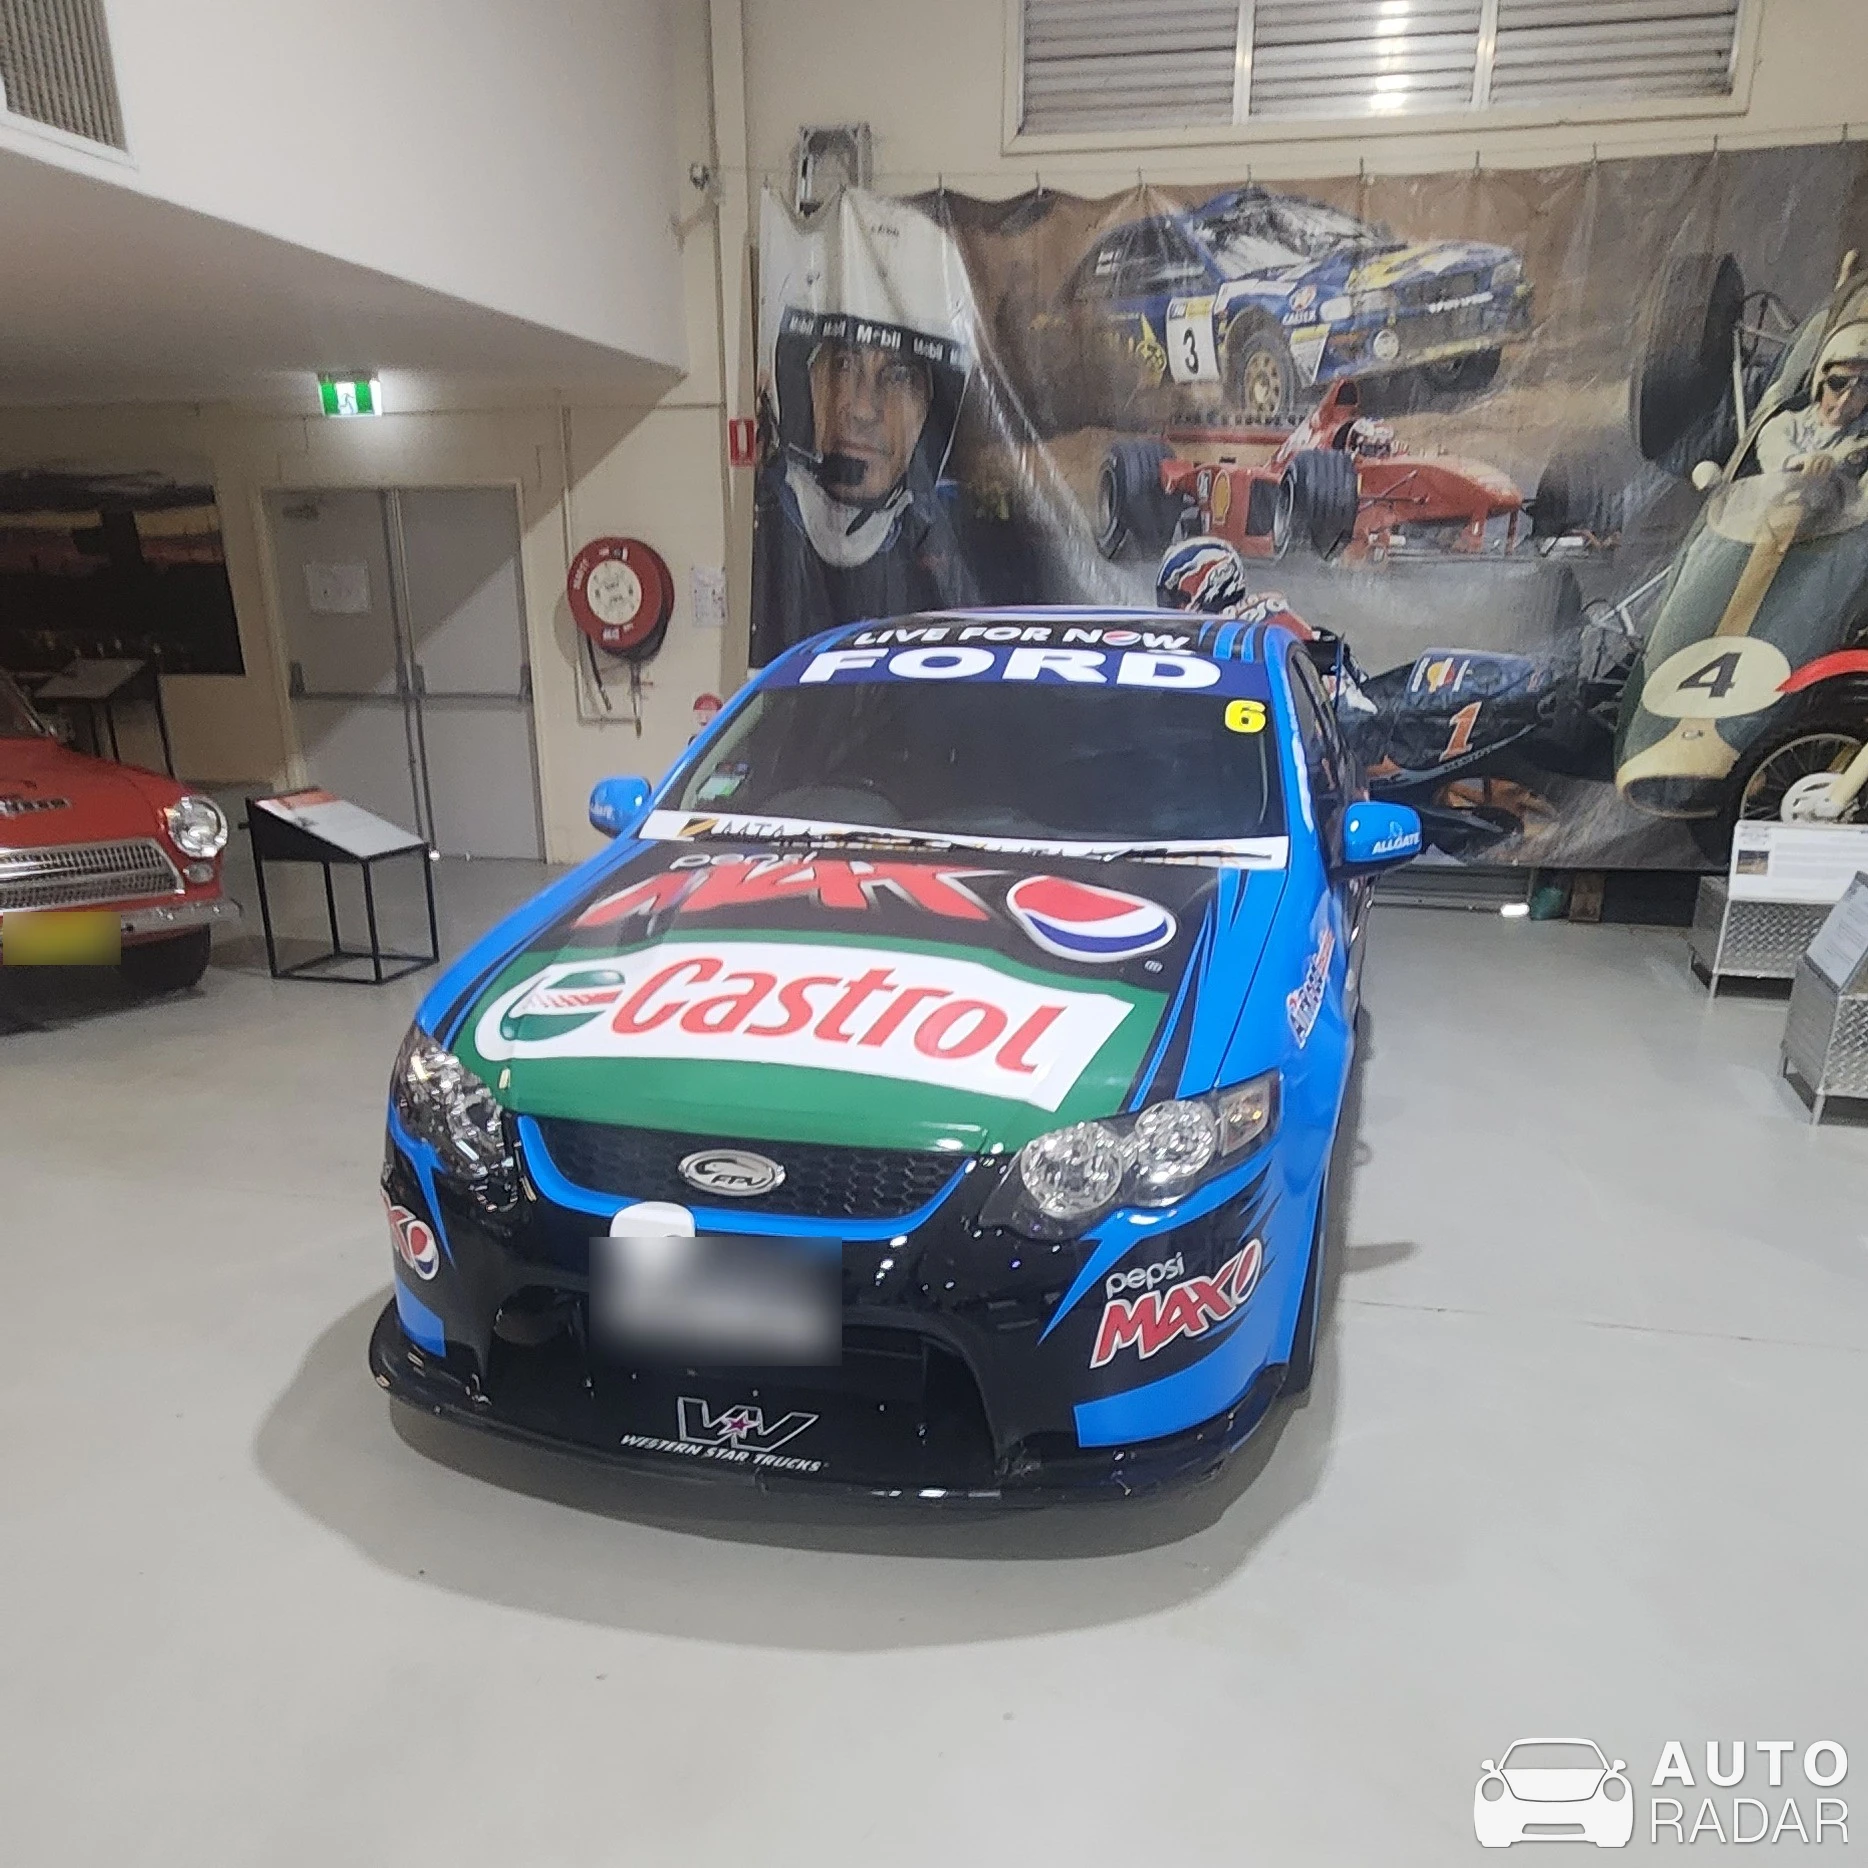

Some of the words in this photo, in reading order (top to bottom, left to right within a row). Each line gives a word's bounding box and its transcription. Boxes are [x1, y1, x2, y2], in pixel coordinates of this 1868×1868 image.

[1183, 328, 1199, 374] 3
[854, 627, 949, 645] LIVE
[958, 626, 1051, 641] FOR
[1062, 629, 1190, 649] NOW
[800, 647, 1220, 688] FORD
[1677, 651, 1742, 698] 4
[1225, 701, 1265, 732] 6
[1438, 701, 1482, 762] 1
[611, 957, 1067, 1075] Castrol
[1106, 1251, 1185, 1299] pepsi
[1089, 1250, 1243, 1369] MAX
[620, 1434, 704, 1456] WESTERN
[703, 1447, 749, 1462] STAR
[752, 1453, 823, 1473] TRUCKS
